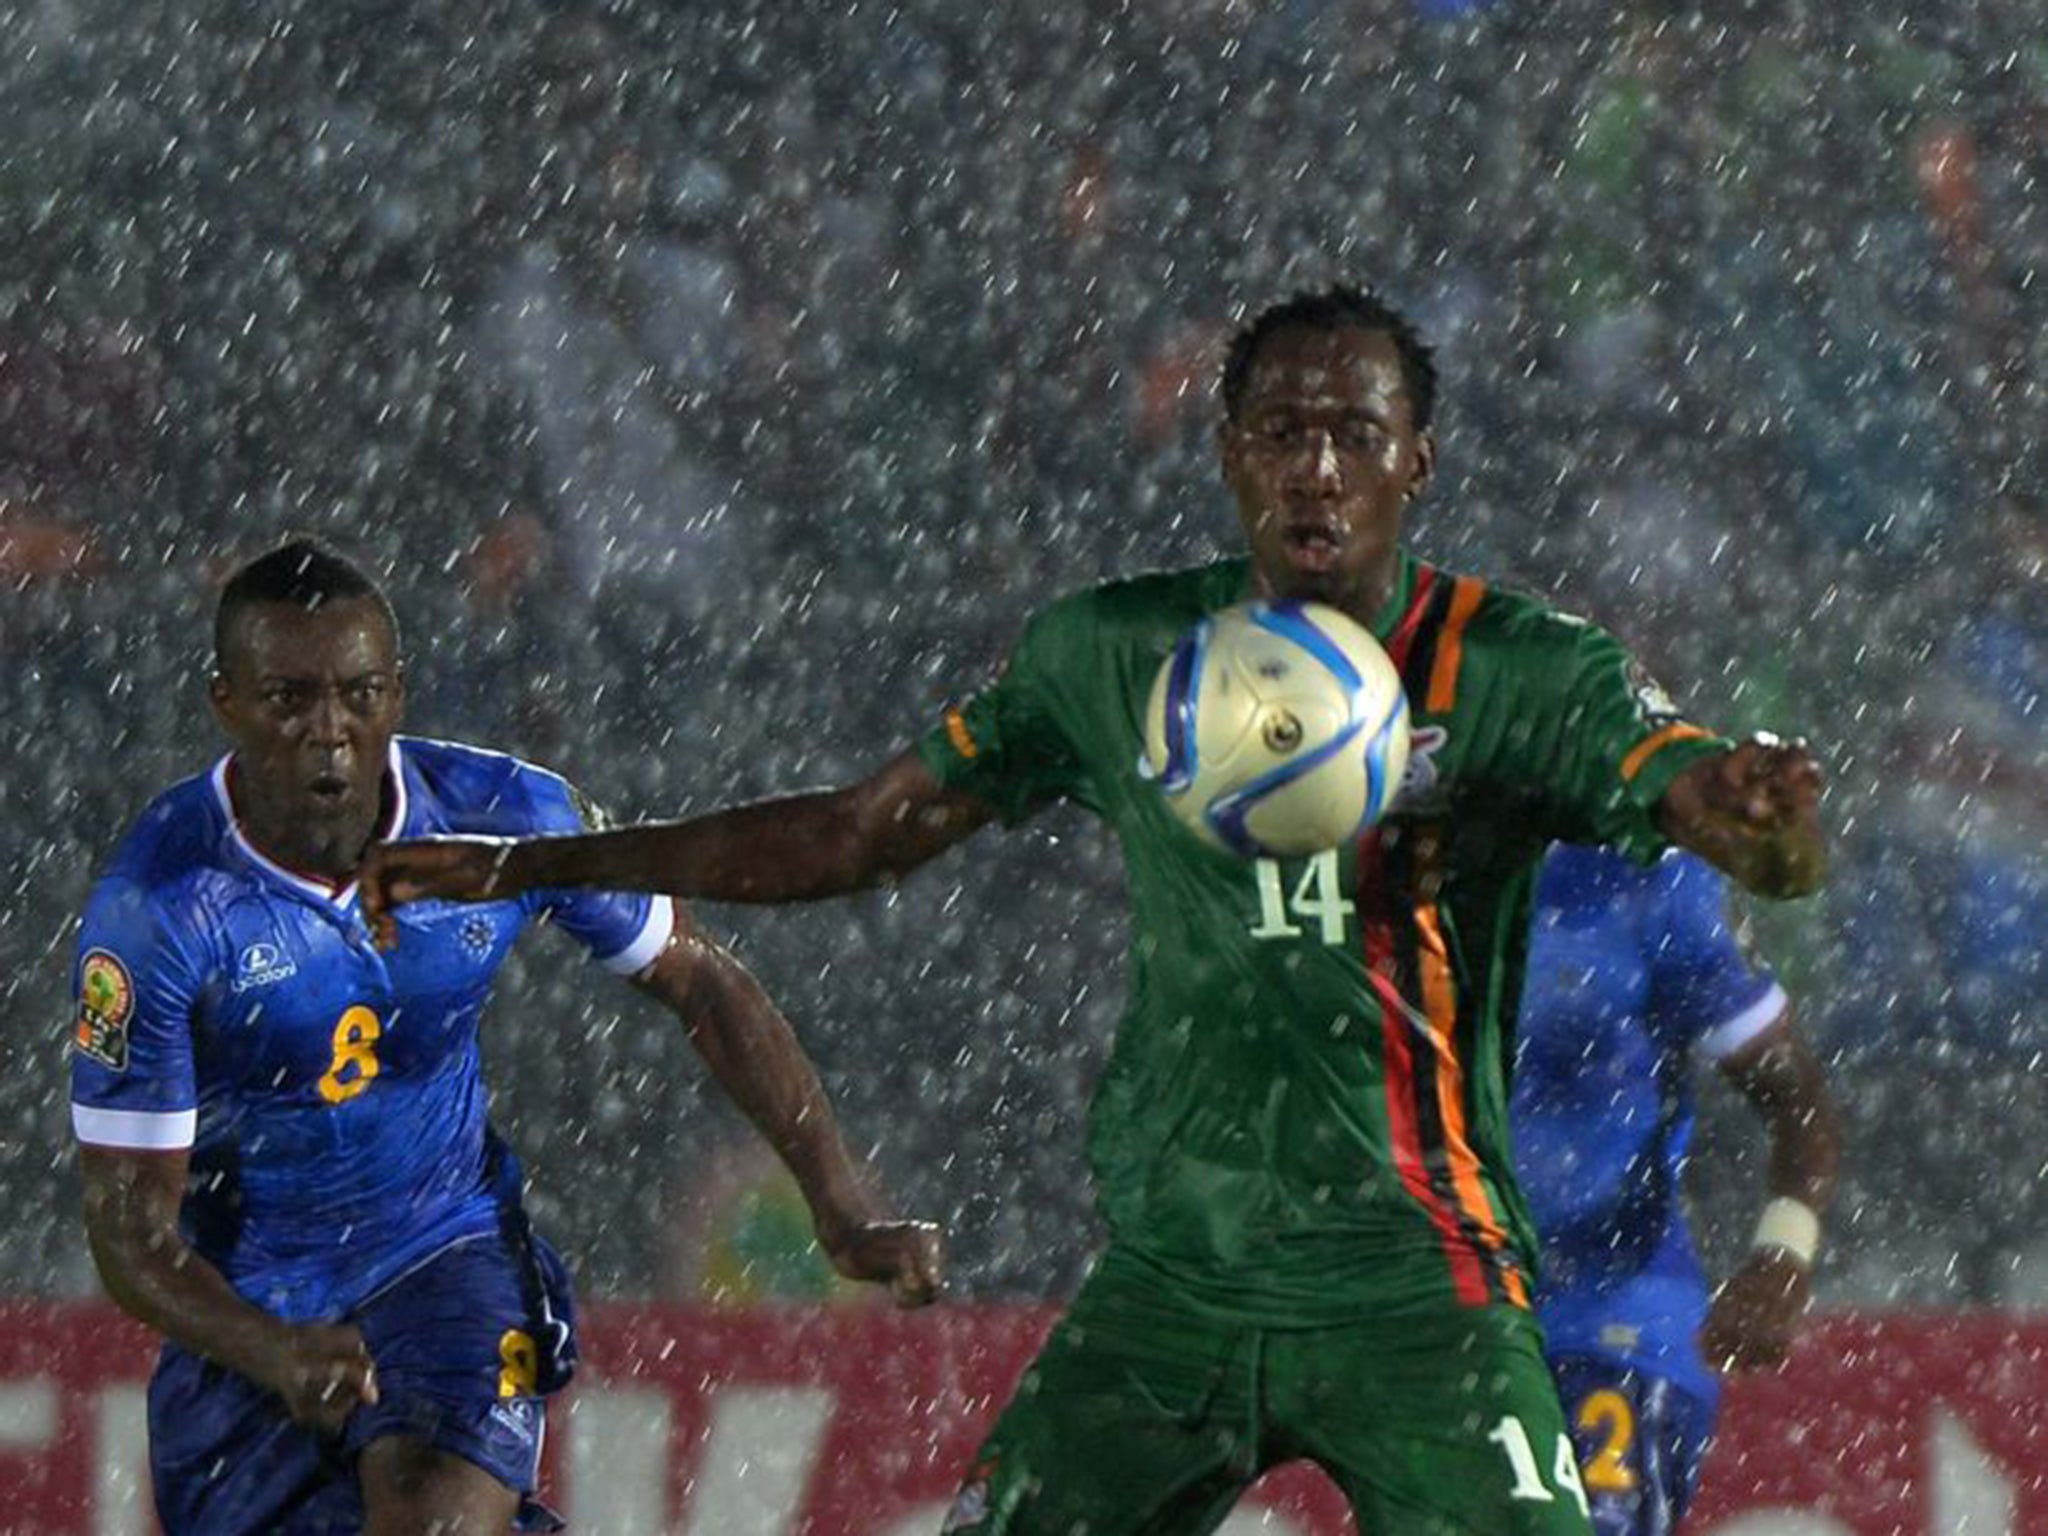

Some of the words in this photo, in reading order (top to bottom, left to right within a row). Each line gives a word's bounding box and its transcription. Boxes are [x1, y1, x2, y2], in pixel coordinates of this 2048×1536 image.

[1250, 847, 1355, 945] 14
[317, 1004, 381, 1105] 8
[1487, 1415, 1591, 1518] 14
[1579, 1388, 1638, 1490] 2
